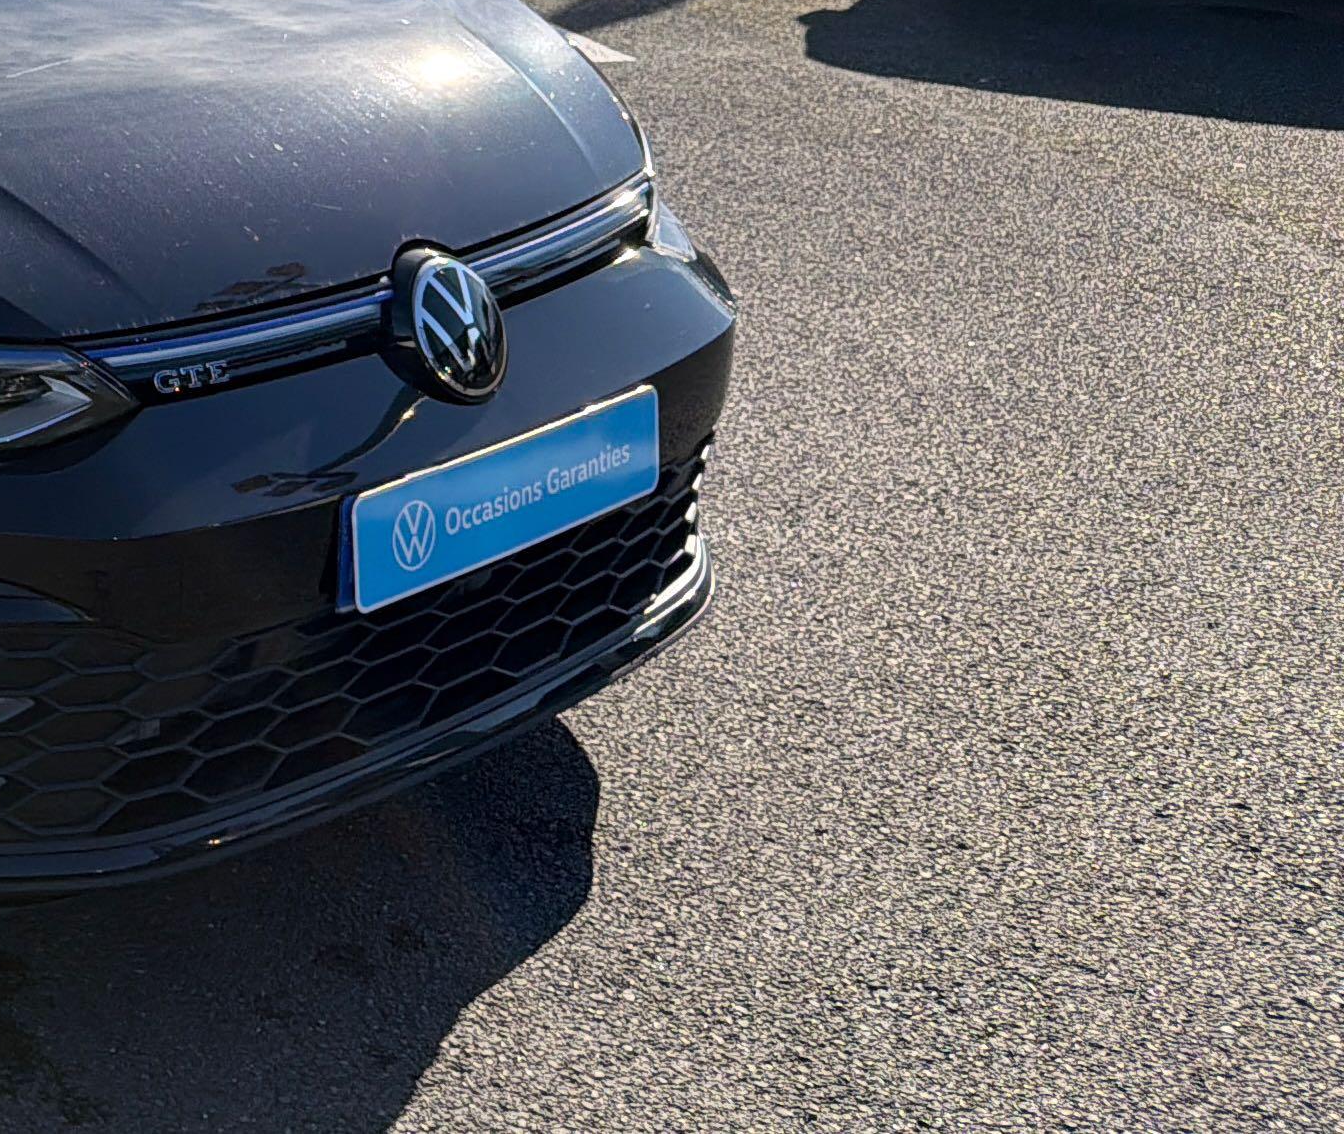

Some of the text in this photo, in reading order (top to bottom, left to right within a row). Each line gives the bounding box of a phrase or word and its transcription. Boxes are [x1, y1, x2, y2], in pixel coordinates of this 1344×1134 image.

[154, 359, 230, 394] GTE
[445, 480, 543, 536] Occasions
[546, 443, 632, 495] Garanties
